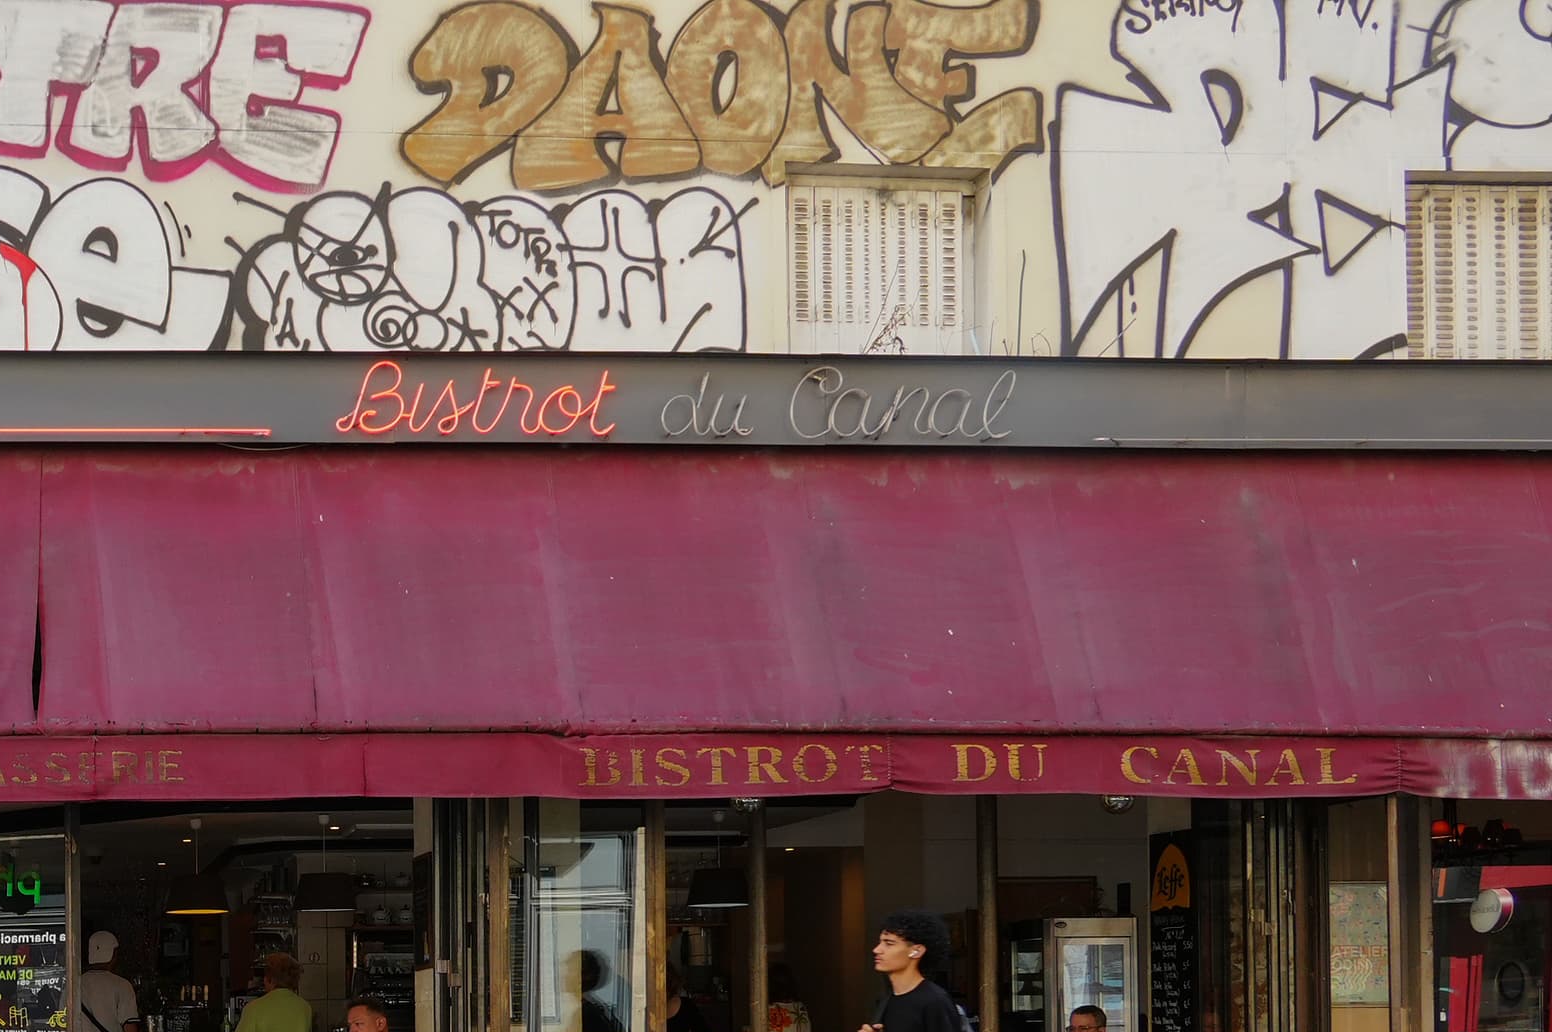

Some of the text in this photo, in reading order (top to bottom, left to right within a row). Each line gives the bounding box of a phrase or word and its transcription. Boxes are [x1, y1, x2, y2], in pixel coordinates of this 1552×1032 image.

[336, 360, 1017, 441] Bistrot du Canal
[578, 743, 1359, 788] BISTROT DU CANAL
